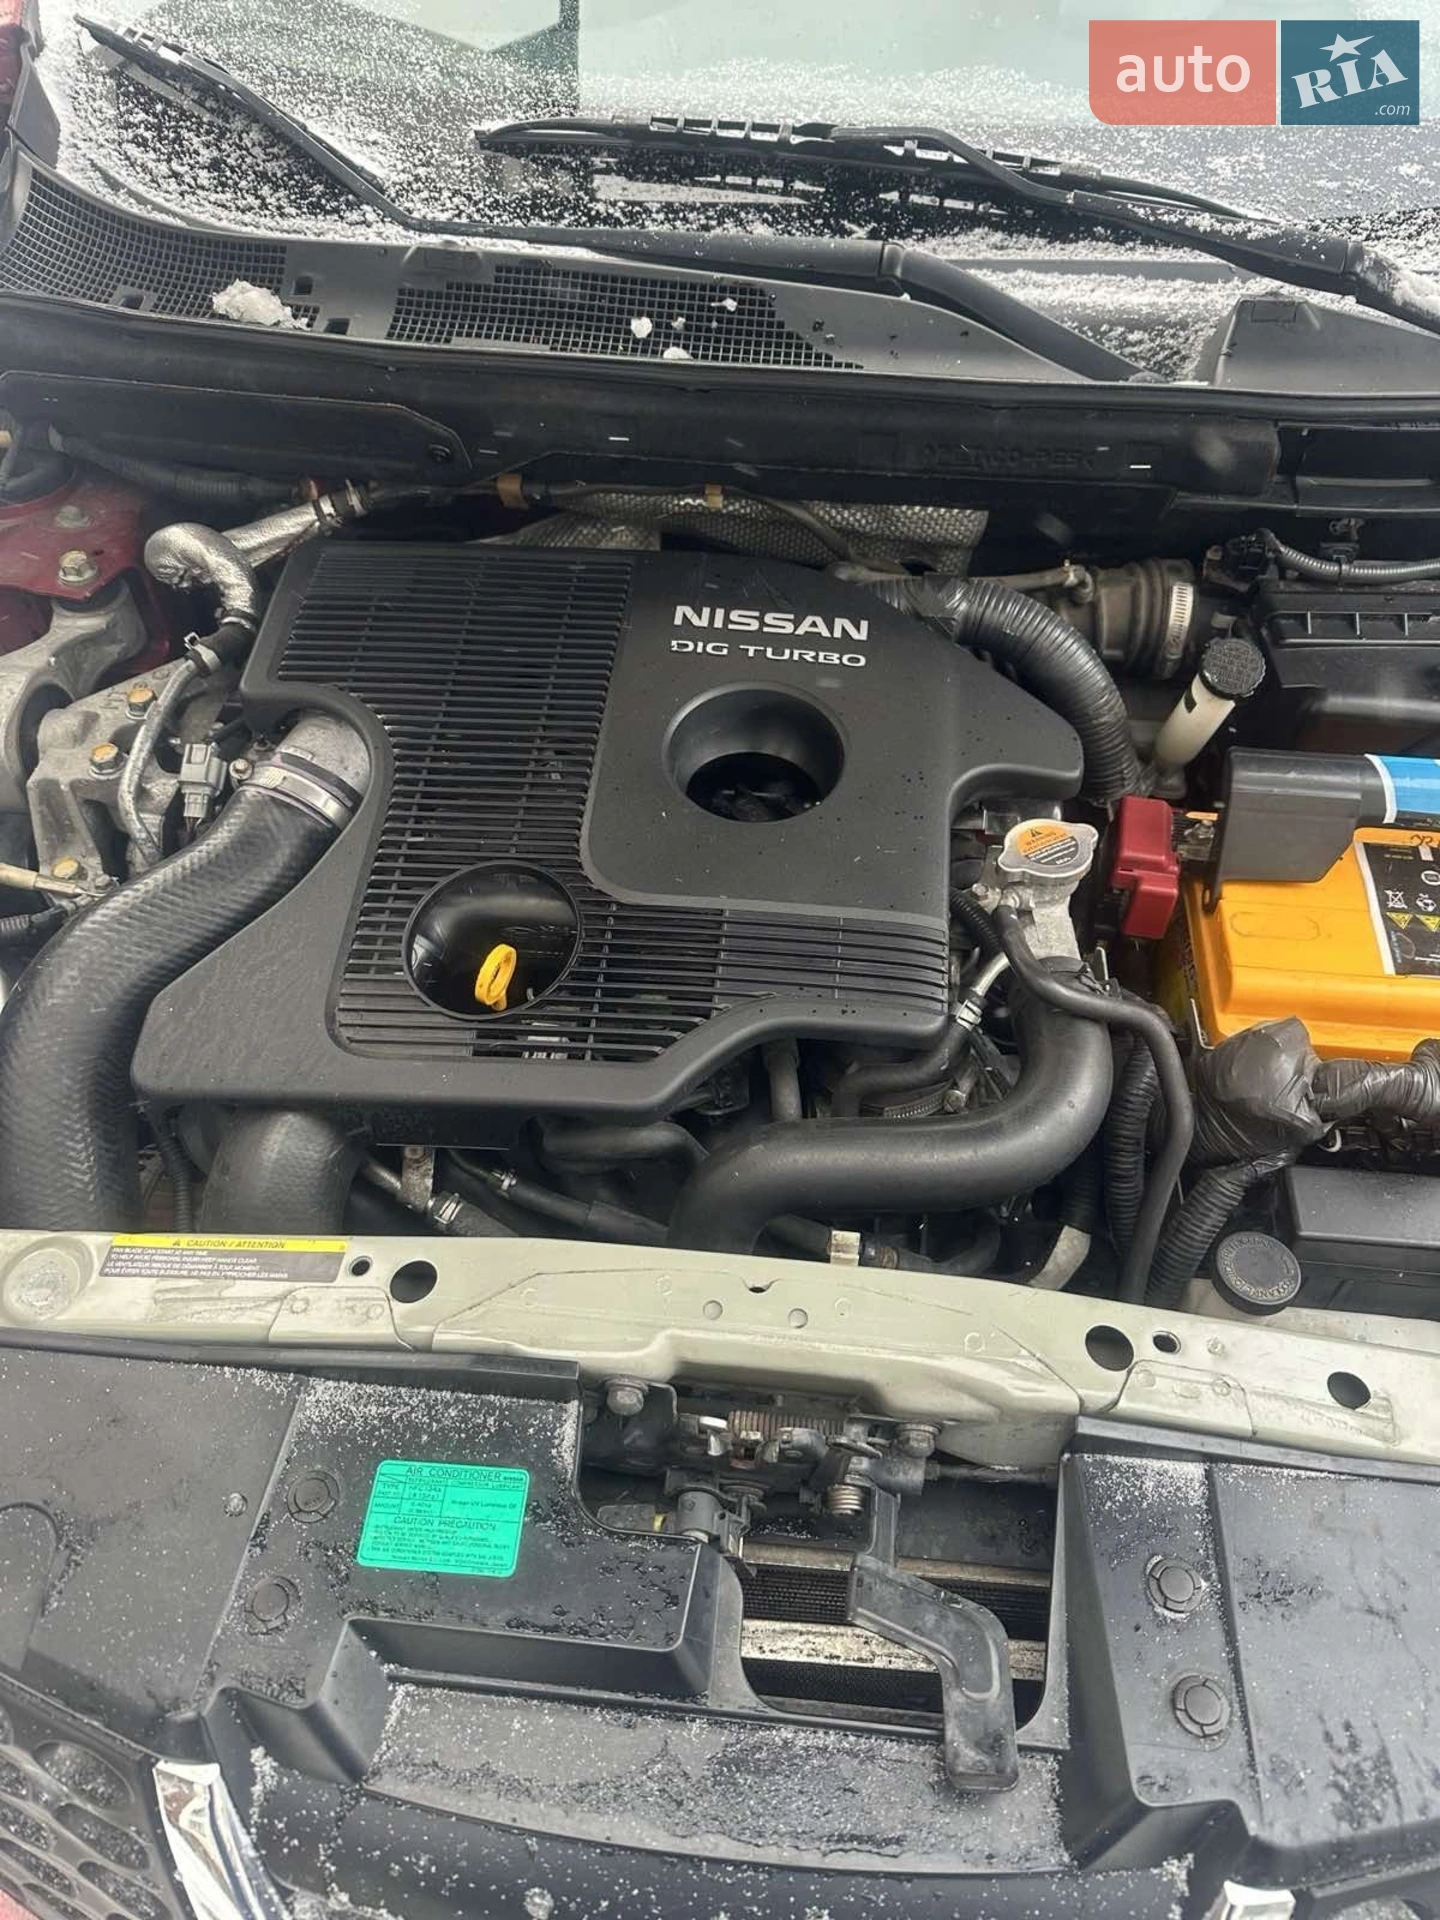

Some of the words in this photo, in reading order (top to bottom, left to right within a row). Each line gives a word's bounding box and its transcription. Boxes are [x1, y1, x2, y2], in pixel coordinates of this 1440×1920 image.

[673, 605, 869, 641] NISSAN
[670, 640, 729, 655] DIG
[738, 645, 867, 667] TURBO
[235, 1241, 286, 1249] ATTENTION
[406, 1466, 424, 1476] AIR
[429, 1467, 501, 1481] CONDITIONER
[394, 1516, 434, 1527] CAUTION
